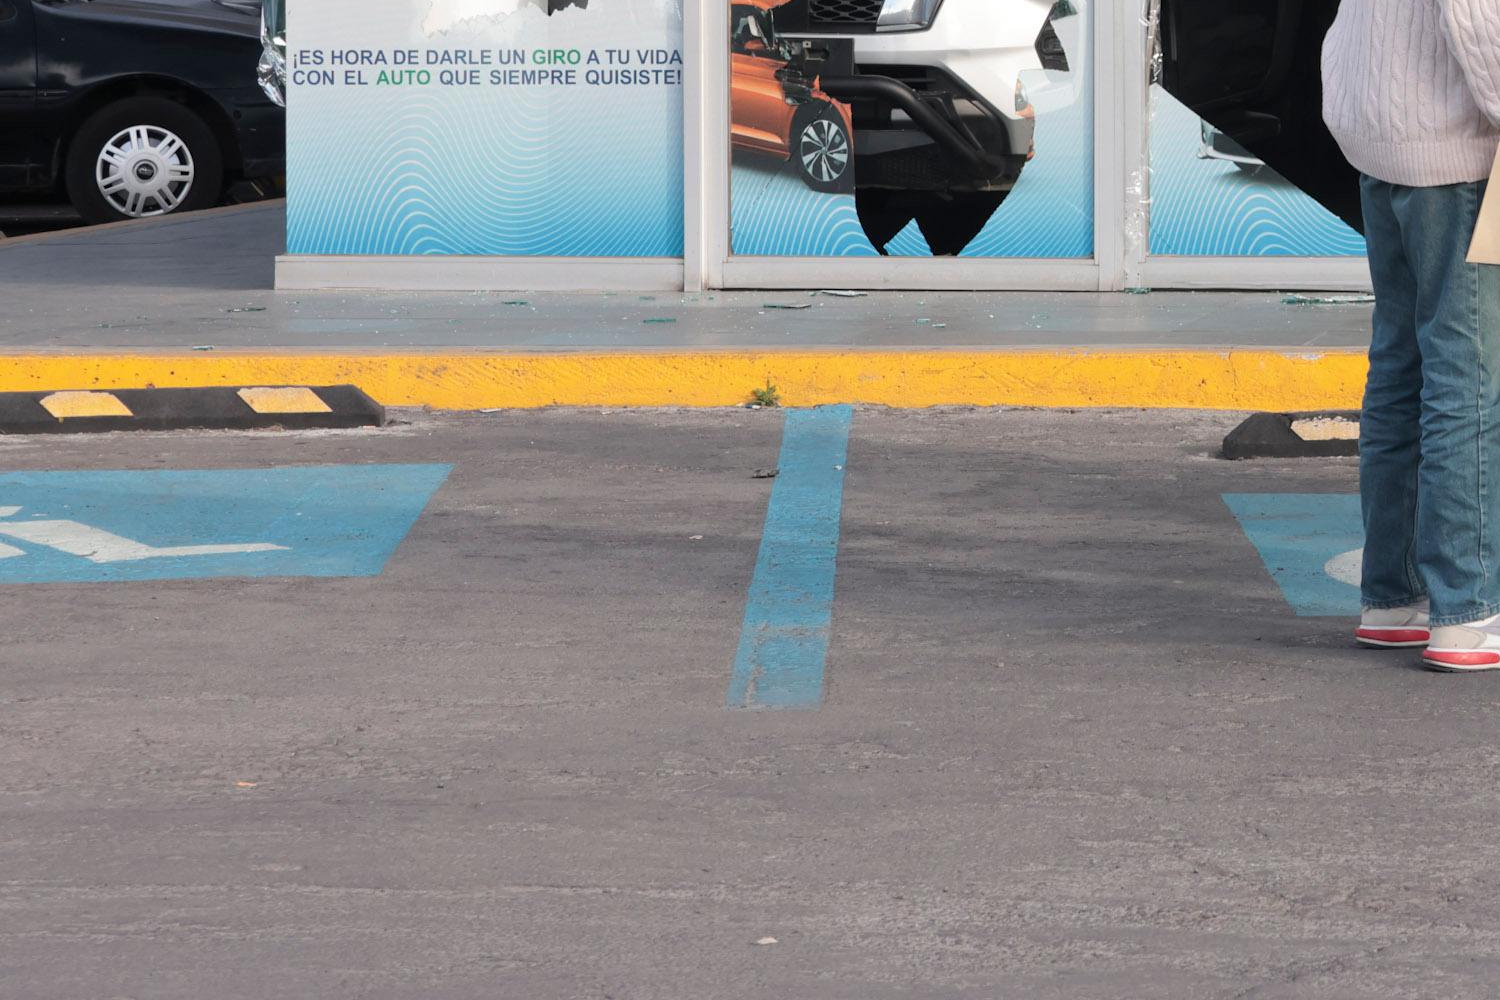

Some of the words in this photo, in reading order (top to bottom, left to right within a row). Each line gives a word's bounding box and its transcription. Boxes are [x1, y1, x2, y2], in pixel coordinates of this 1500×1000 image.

[293, 49, 323, 68] ¡ES
[331, 49, 387, 65] HORA
[394, 49, 419, 65] DE
[427, 49, 492, 65] DARLE
[499, 49, 525, 65] UN
[532, 49, 581, 65] GIRO
[587, 49, 600, 65] A
[605, 49, 629, 65] TU
[637, 49, 682, 65] VIDA
[293, 69, 334, 85] CON
[345, 69, 368, 85] EL
[376, 69, 431, 85] AUTO
[439, 69, 481, 85] QUE
[490, 69, 576, 85] SIEMPRE
[585, 69, 682, 85] QUISISTE!
